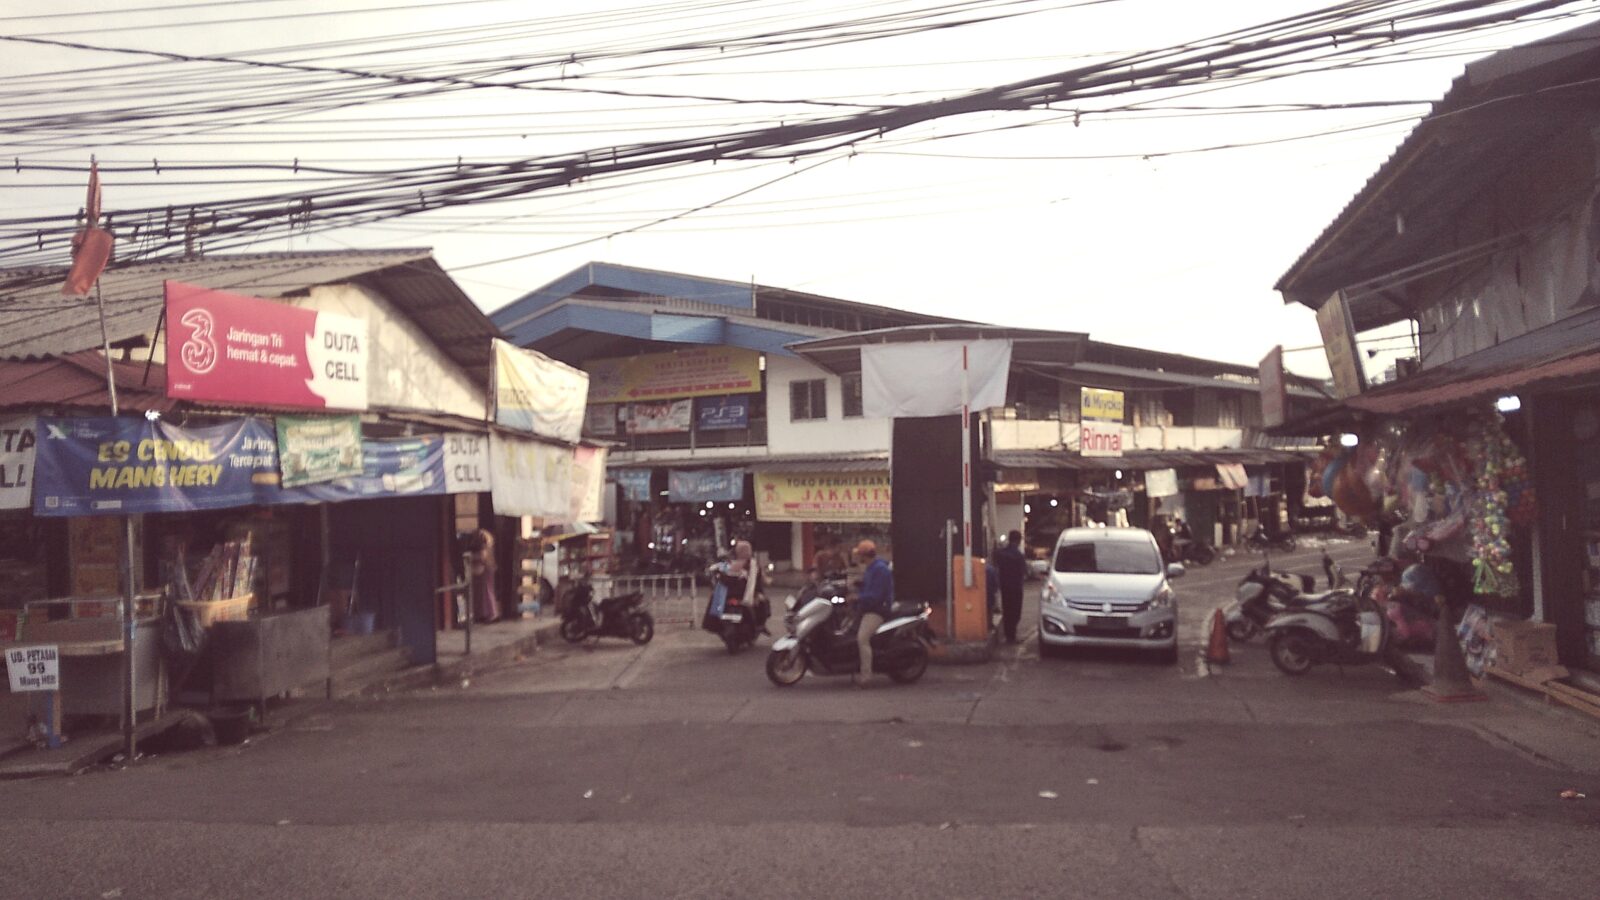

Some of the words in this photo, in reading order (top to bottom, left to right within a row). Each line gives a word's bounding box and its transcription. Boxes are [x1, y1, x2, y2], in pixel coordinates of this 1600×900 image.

[226, 327, 269, 347] Jaringan
[271, 333, 283, 348] Tri
[323, 332, 360, 354] DUTA
[226, 346, 259, 362] hemat
[260, 350, 267, 362] &
[325, 360, 360, 381] CELL
[701, 406, 744, 419] PS3
[98, 440, 131, 462] ES
[137, 438, 217, 462] CENDOL
[90, 465, 165, 489] MANG
[169, 464, 223, 488] HERY
[787, 477, 815, 488] TOKO
[28, 662, 45, 674] 99
